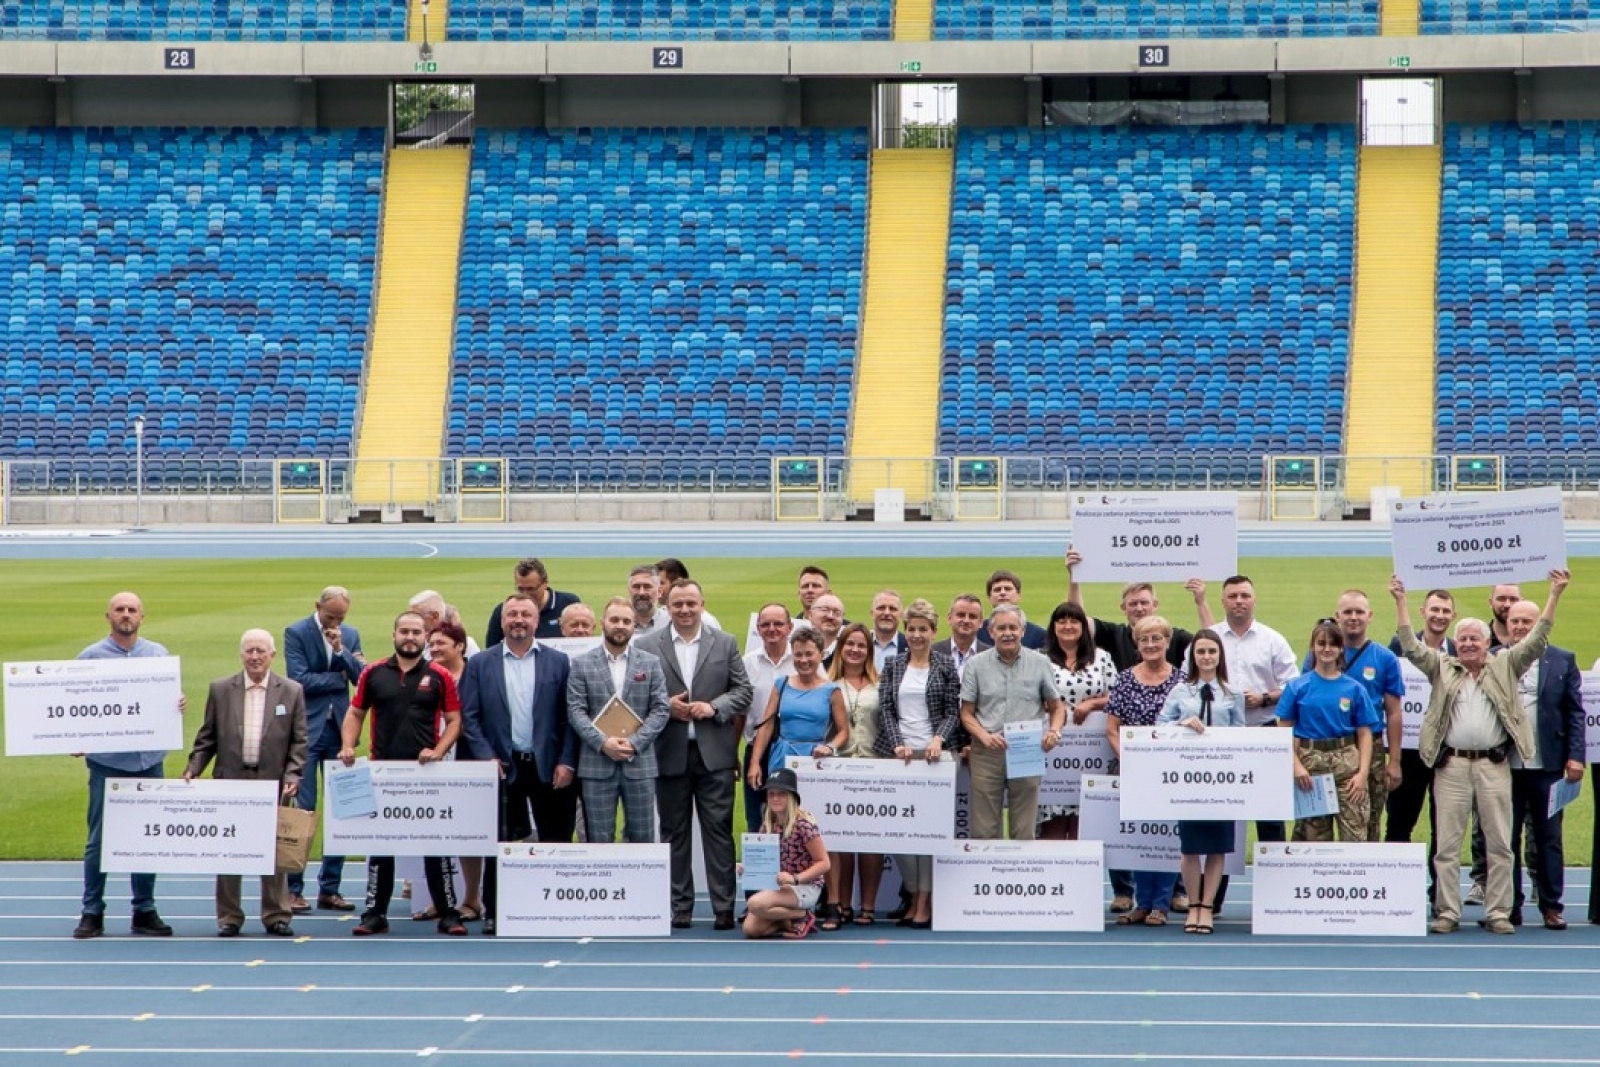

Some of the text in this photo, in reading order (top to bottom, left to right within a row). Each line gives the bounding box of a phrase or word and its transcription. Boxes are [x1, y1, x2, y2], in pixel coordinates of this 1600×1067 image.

[170, 51, 189, 66] 28
[659, 50, 677, 64] 29
[1145, 48, 1163, 63] 30
[1449, 522, 1473, 530] Program
[1111, 534, 1199, 548] 15 000,00 zł
[1437, 535, 1521, 552] 8 000,00 zł
[47, 702, 140, 718] 10 000,00 zł
[1053, 758, 1102, 771] 000,00
[1162, 771, 1254, 785] 10 000,00 zł
[383, 807, 434, 820] 000,00
[440, 806, 453, 819] zł
[825, 803, 914, 818] 10 000,00 zł
[144, 824, 236, 838] 15 000,00 zł
[1120, 822, 1180, 836] 15 000,0
[543, 887, 626, 901] 7 000,00 zł
[974, 884, 1064, 897] 10 000,00 zł
[1294, 887, 1386, 900] 15 000,00 zł
